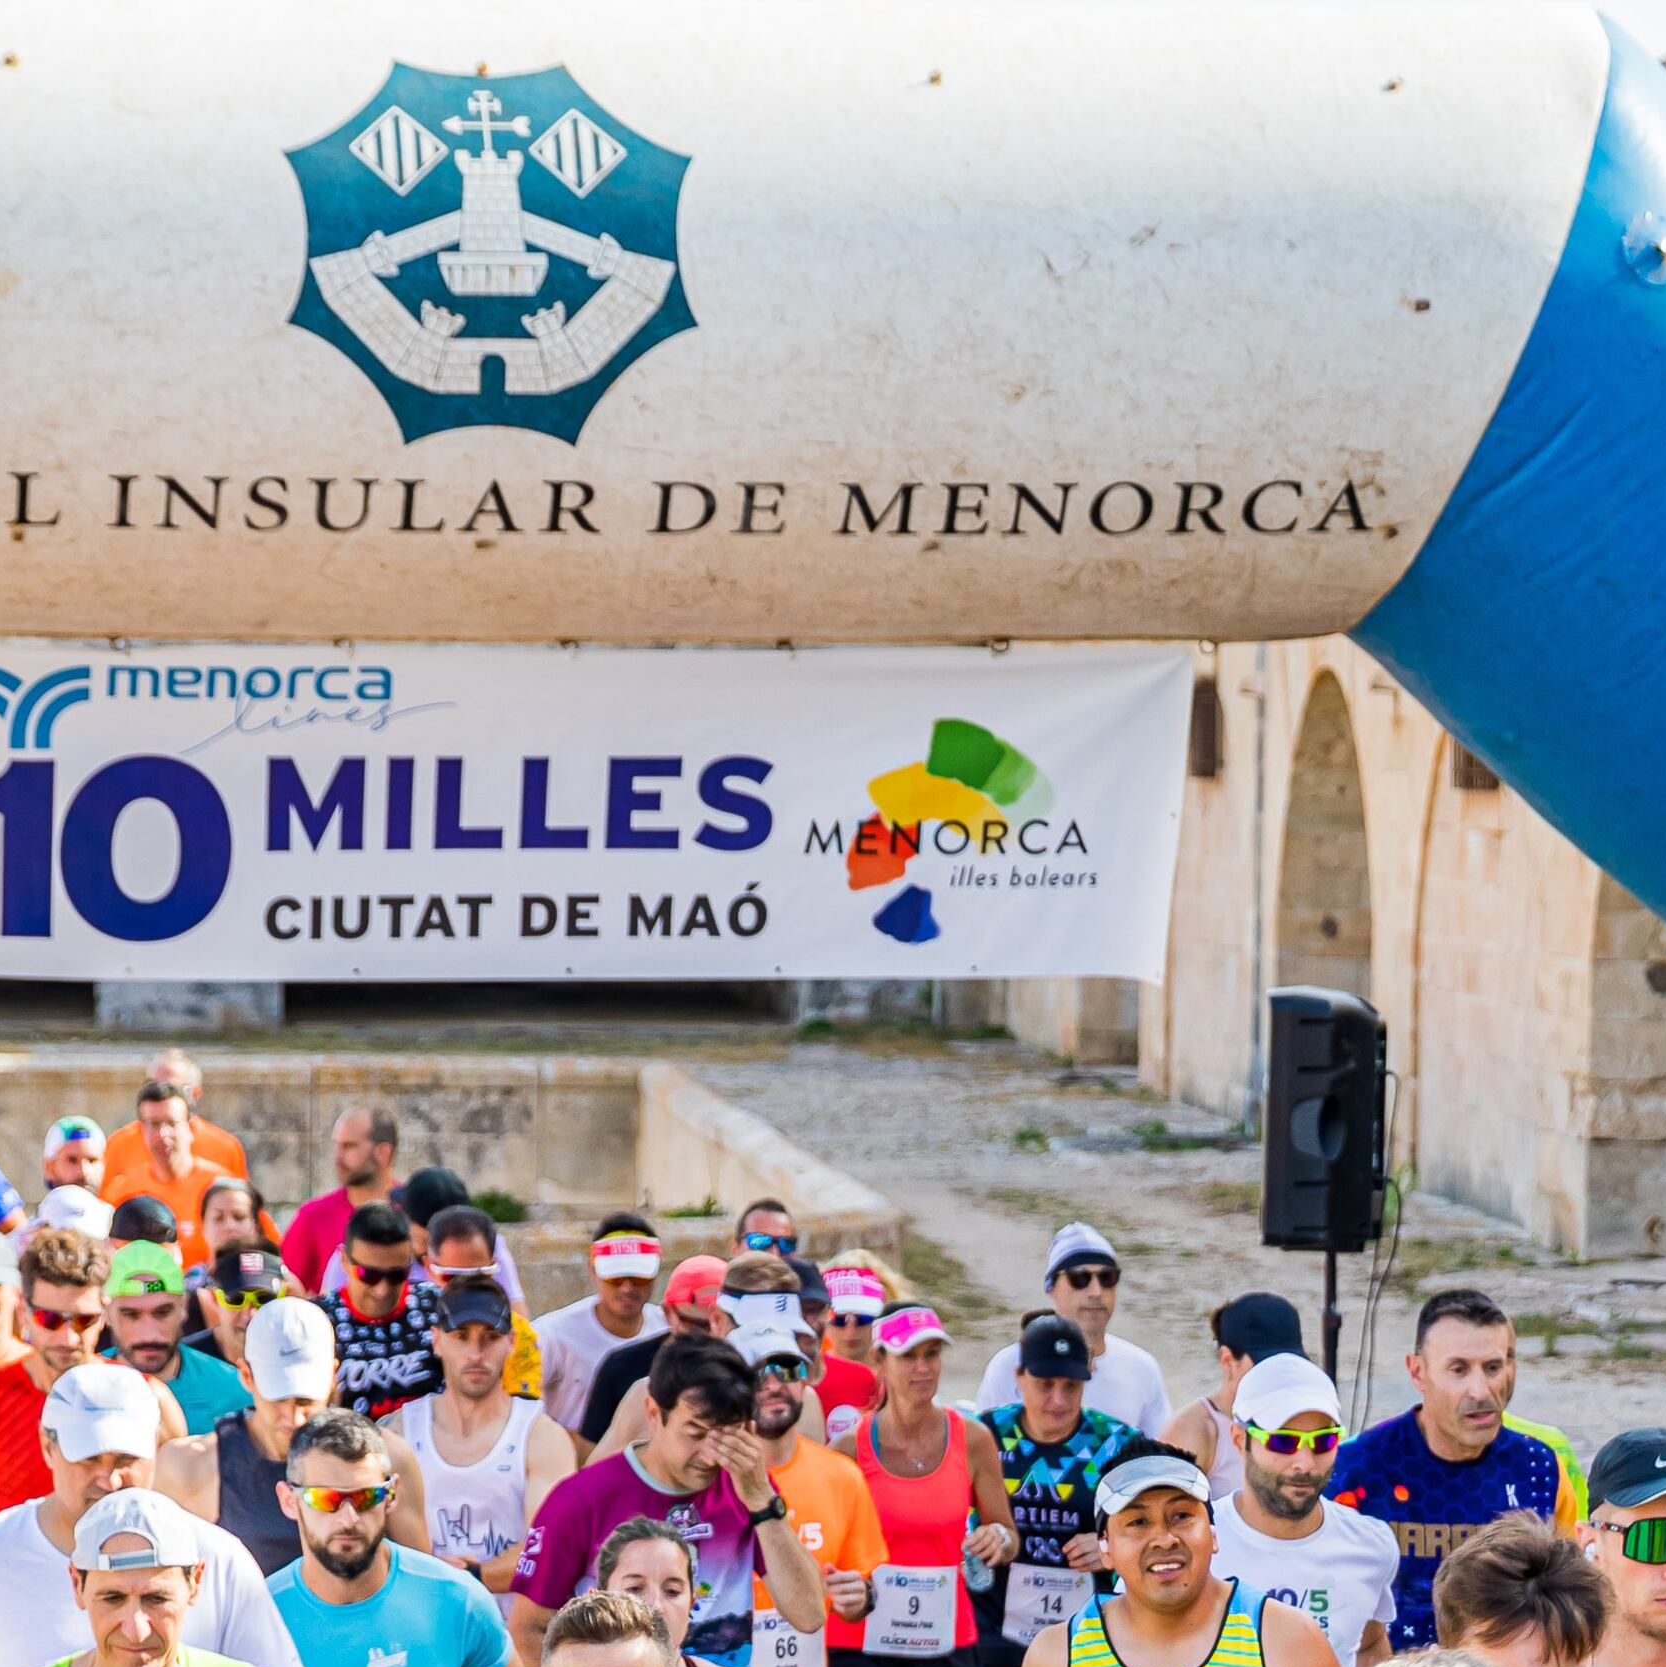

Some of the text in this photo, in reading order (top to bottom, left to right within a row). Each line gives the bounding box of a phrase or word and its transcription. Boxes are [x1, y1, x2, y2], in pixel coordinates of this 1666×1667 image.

[104, 472, 601, 536] INSULAR
[646, 480, 787, 535] DE
[837, 479, 1377, 536] MENORCA
[104, 663, 394, 701] menorca
[265, 754, 776, 853] MILLES
[802, 818, 1089, 856] MENORCA
[949, 865, 1100, 888] illes balears
[263, 880, 770, 941] CIUTAT DE MAÓ
[1013, 1506, 1080, 1526] RTIEM
[907, 1595, 920, 1616] 9
[1040, 1594, 1064, 1614] 14
[775, 1635, 798, 1659] 66
